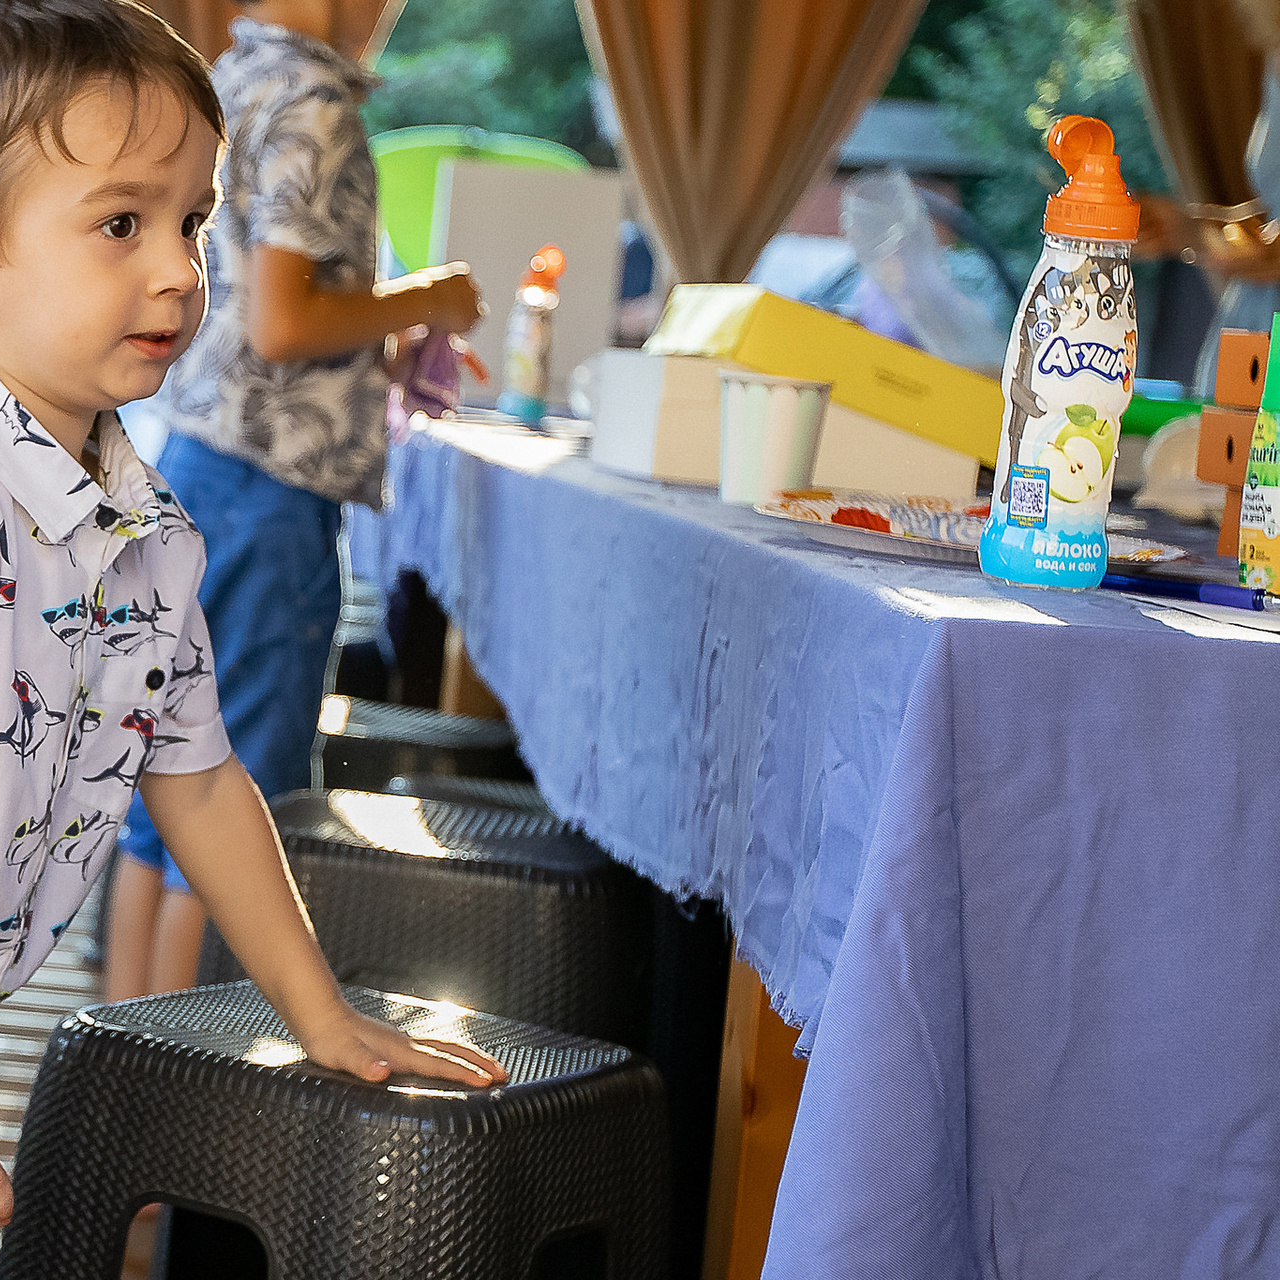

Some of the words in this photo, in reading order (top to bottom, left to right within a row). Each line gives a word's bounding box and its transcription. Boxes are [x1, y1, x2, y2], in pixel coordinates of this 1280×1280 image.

[1033, 539, 1102, 559] ЯБЛОКО
[1035, 558, 1066, 571] ВОДА
[1068, 561, 1076, 571] И
[1078, 561, 1097, 572] СОК
